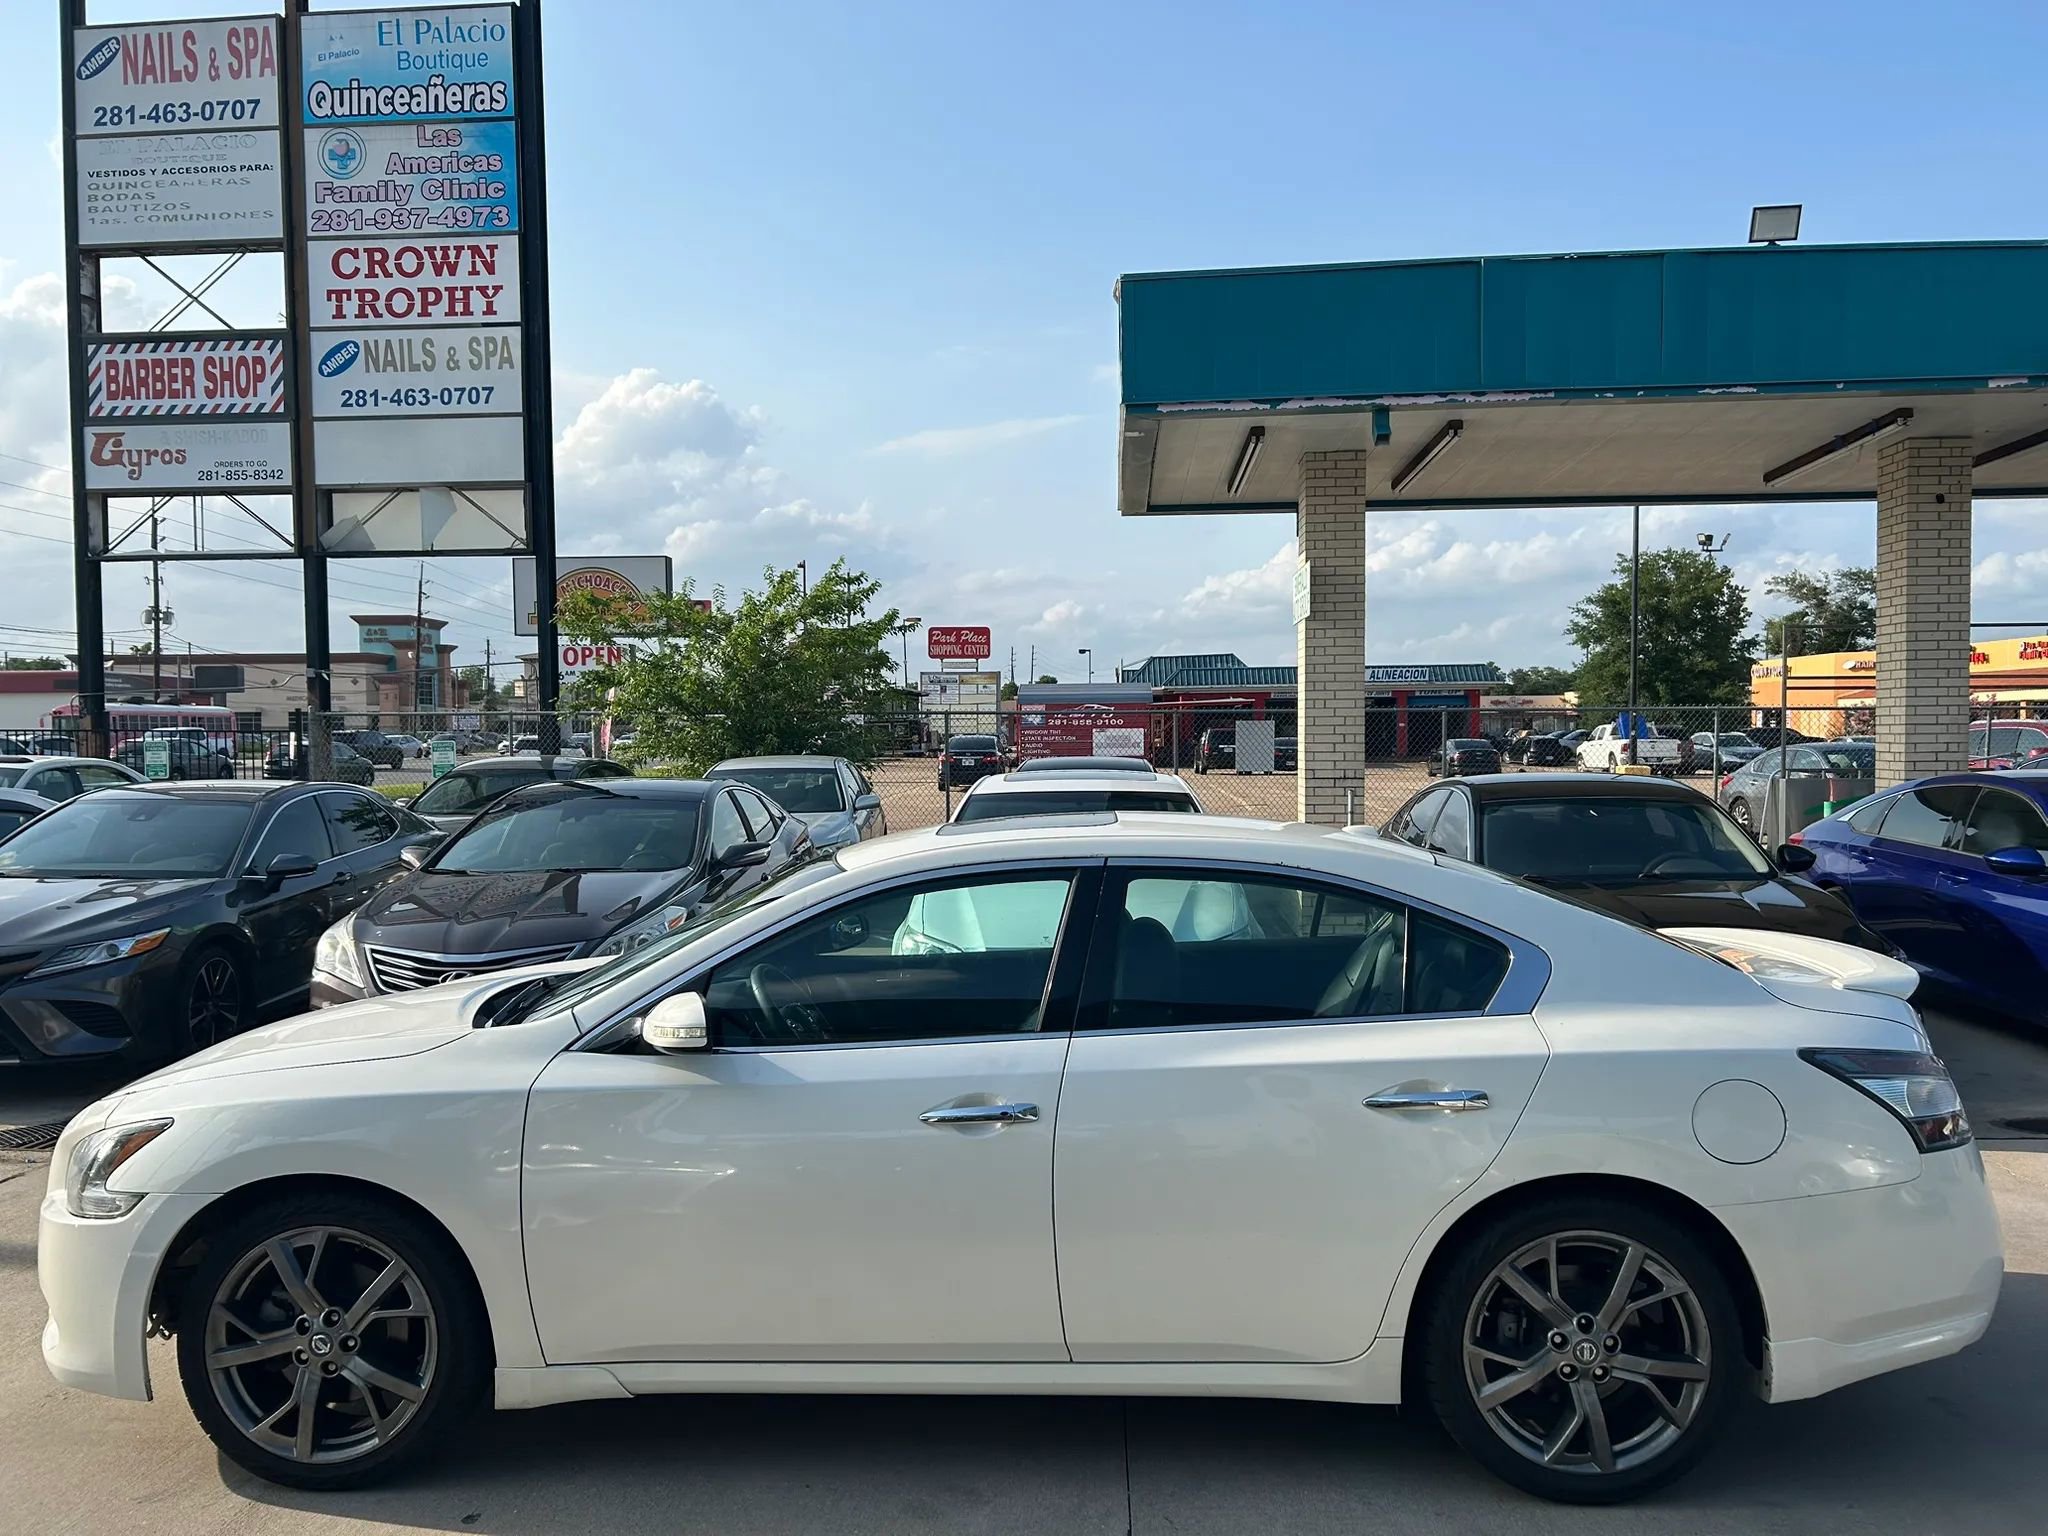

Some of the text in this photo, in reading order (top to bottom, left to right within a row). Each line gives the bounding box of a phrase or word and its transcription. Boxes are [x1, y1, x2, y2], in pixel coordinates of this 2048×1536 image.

[377, 18, 403, 46] El
[79, 38, 121, 79] AMBER
[120, 25, 277, 86] NAILS & SPA
[318, 48, 360, 62] El Palacio
[396, 50, 489, 72] Boutique
[308, 74, 508, 119] Quinceañeras
[94, 98, 261, 127] 281-463-0707
[137, 133, 257, 154] PALACIO
[416, 124, 462, 148] Las
[87, 163, 274, 178] VESTIDOS Y ACCESORIOS PARA:
[385, 151, 503, 175] Americas
[87, 191, 156, 203] BODAS
[314, 177, 505, 206] Family Clinic
[87, 202, 191, 214] BAUTIZOS
[134, 209, 274, 224] COMUNIONES
[311, 205, 510, 232] 281-937-4973
[330, 243, 499, 281] CROWN
[326, 284, 504, 320] TROPHY
[321, 342, 359, 377] AMBER
[363, 335, 515, 374] NAILS & SPA
[105, 355, 267, 401] BARBER SHOP
[340, 386, 495, 408] 281-463-0707
[90, 431, 188, 481] Gyros
[214, 460, 268, 468] ORDERS TO GO
[197, 468, 284, 481] 281-855-8342
[931, 629, 987, 643] Park Place
[563, 646, 622, 667] OPEN
[930, 644, 989, 656] SHOPPING CENTER
[1369, 669, 1428, 681] ALINEACION
